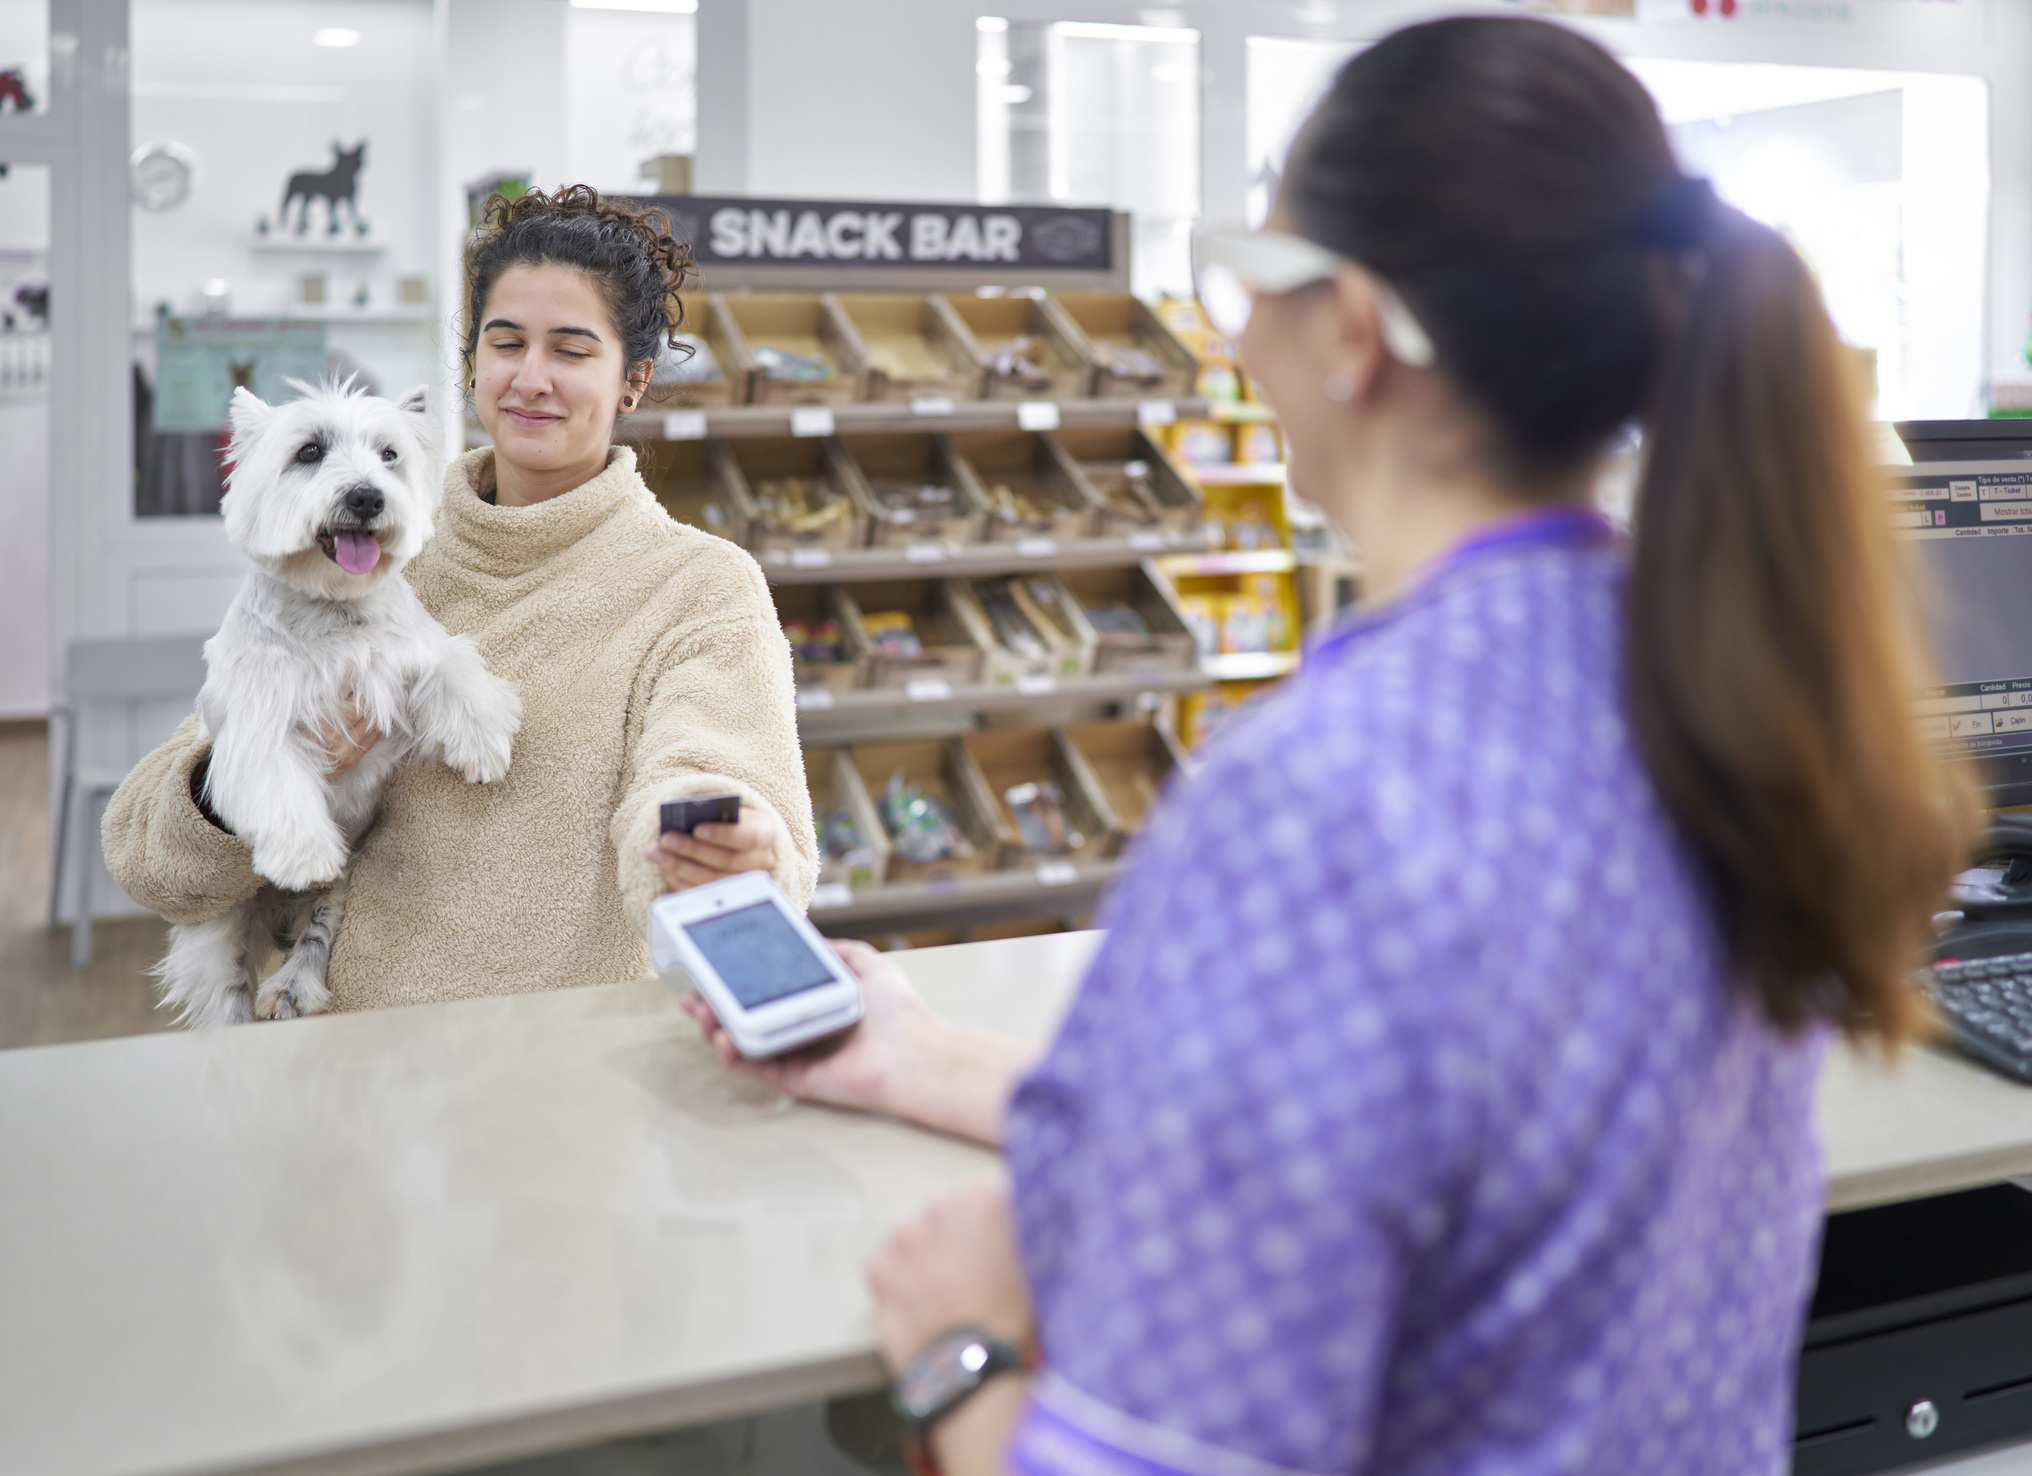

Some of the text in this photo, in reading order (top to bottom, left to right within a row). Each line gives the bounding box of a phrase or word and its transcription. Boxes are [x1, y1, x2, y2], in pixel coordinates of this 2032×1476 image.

[709, 207, 903, 259] SNACK
[910, 213, 1022, 262] BAR
[1978, 476, 1991, 484] Tipo
[1994, 507, 2032, 516] Mostrar tota
[1987, 527, 2009, 537] Importe
[1980, 683, 2006, 692] Cantidad
[2012, 681, 2031, 689] Precio
